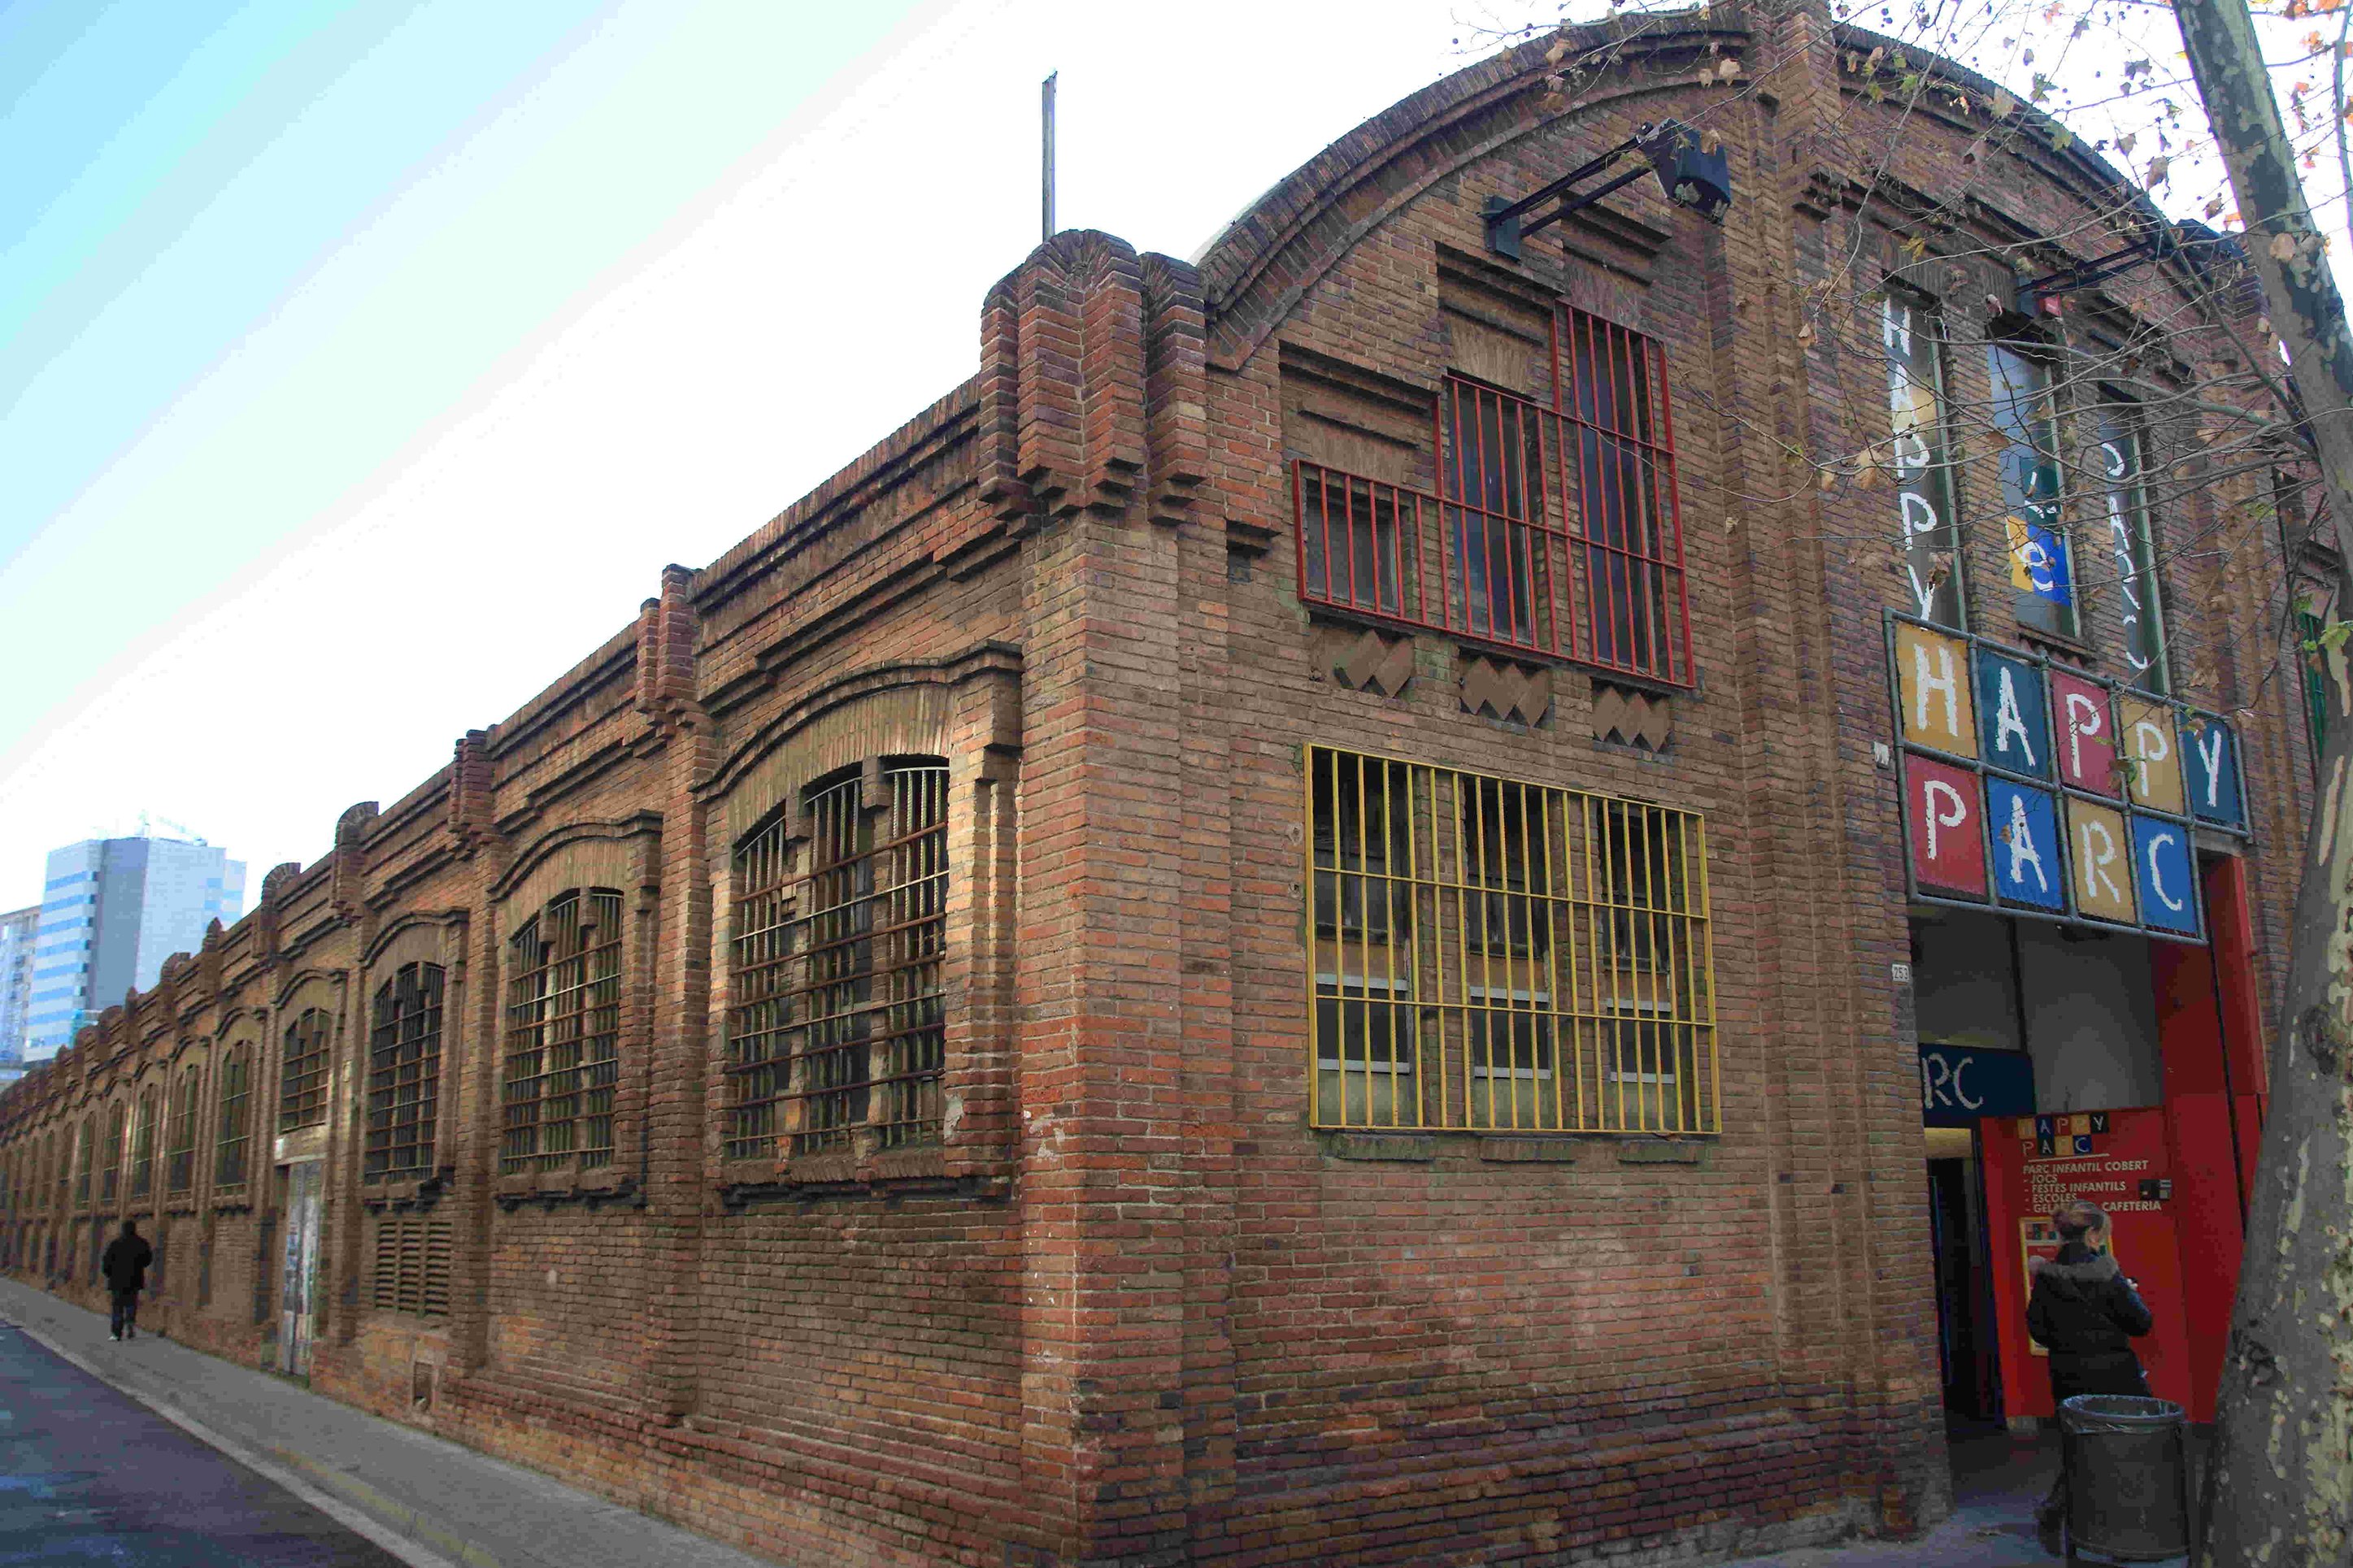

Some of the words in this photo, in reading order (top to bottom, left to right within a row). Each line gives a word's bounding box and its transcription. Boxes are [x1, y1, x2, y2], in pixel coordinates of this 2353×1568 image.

[1914, 644, 2221, 807] HAPPY
[1925, 780, 2184, 911] PARC
[2021, 1115, 2104, 1136] HAPPY
[2022, 1137, 2090, 1156] PARC
[2022, 1164, 2050, 1175] PARC
[2052, 1162, 2102, 1173] INFANTIL
[2105, 1160, 2149, 1171] COBERT
[2030, 1175, 2058, 1184] JOCS
[2031, 1183, 2067, 1193] FESTES
[2069, 1181, 2126, 1192] INFANTILS
[2033, 1193, 2077, 1203] ESCOLES
[2102, 1201, 2162, 1212] CAFETERIA
